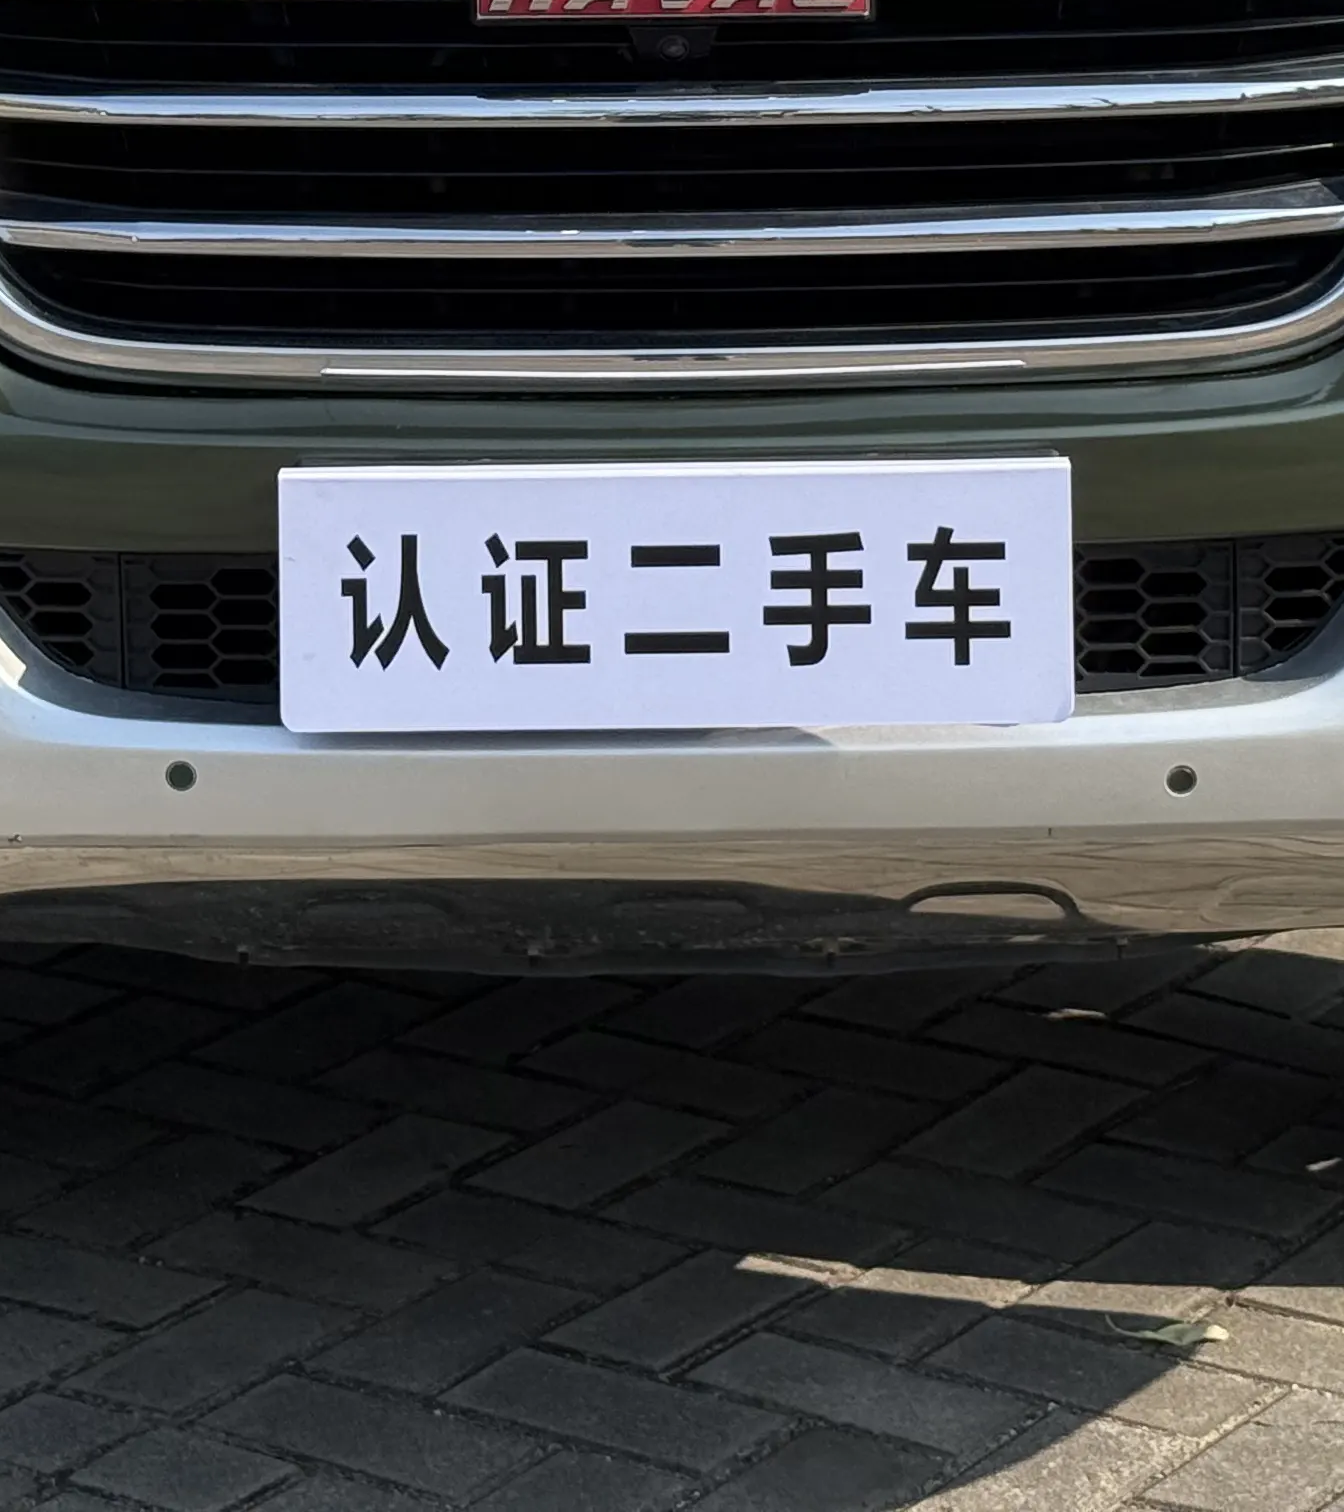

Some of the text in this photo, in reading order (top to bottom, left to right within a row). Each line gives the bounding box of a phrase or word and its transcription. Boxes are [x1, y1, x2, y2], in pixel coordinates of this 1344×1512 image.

[340, 526, 1013, 671] 认证二手车
